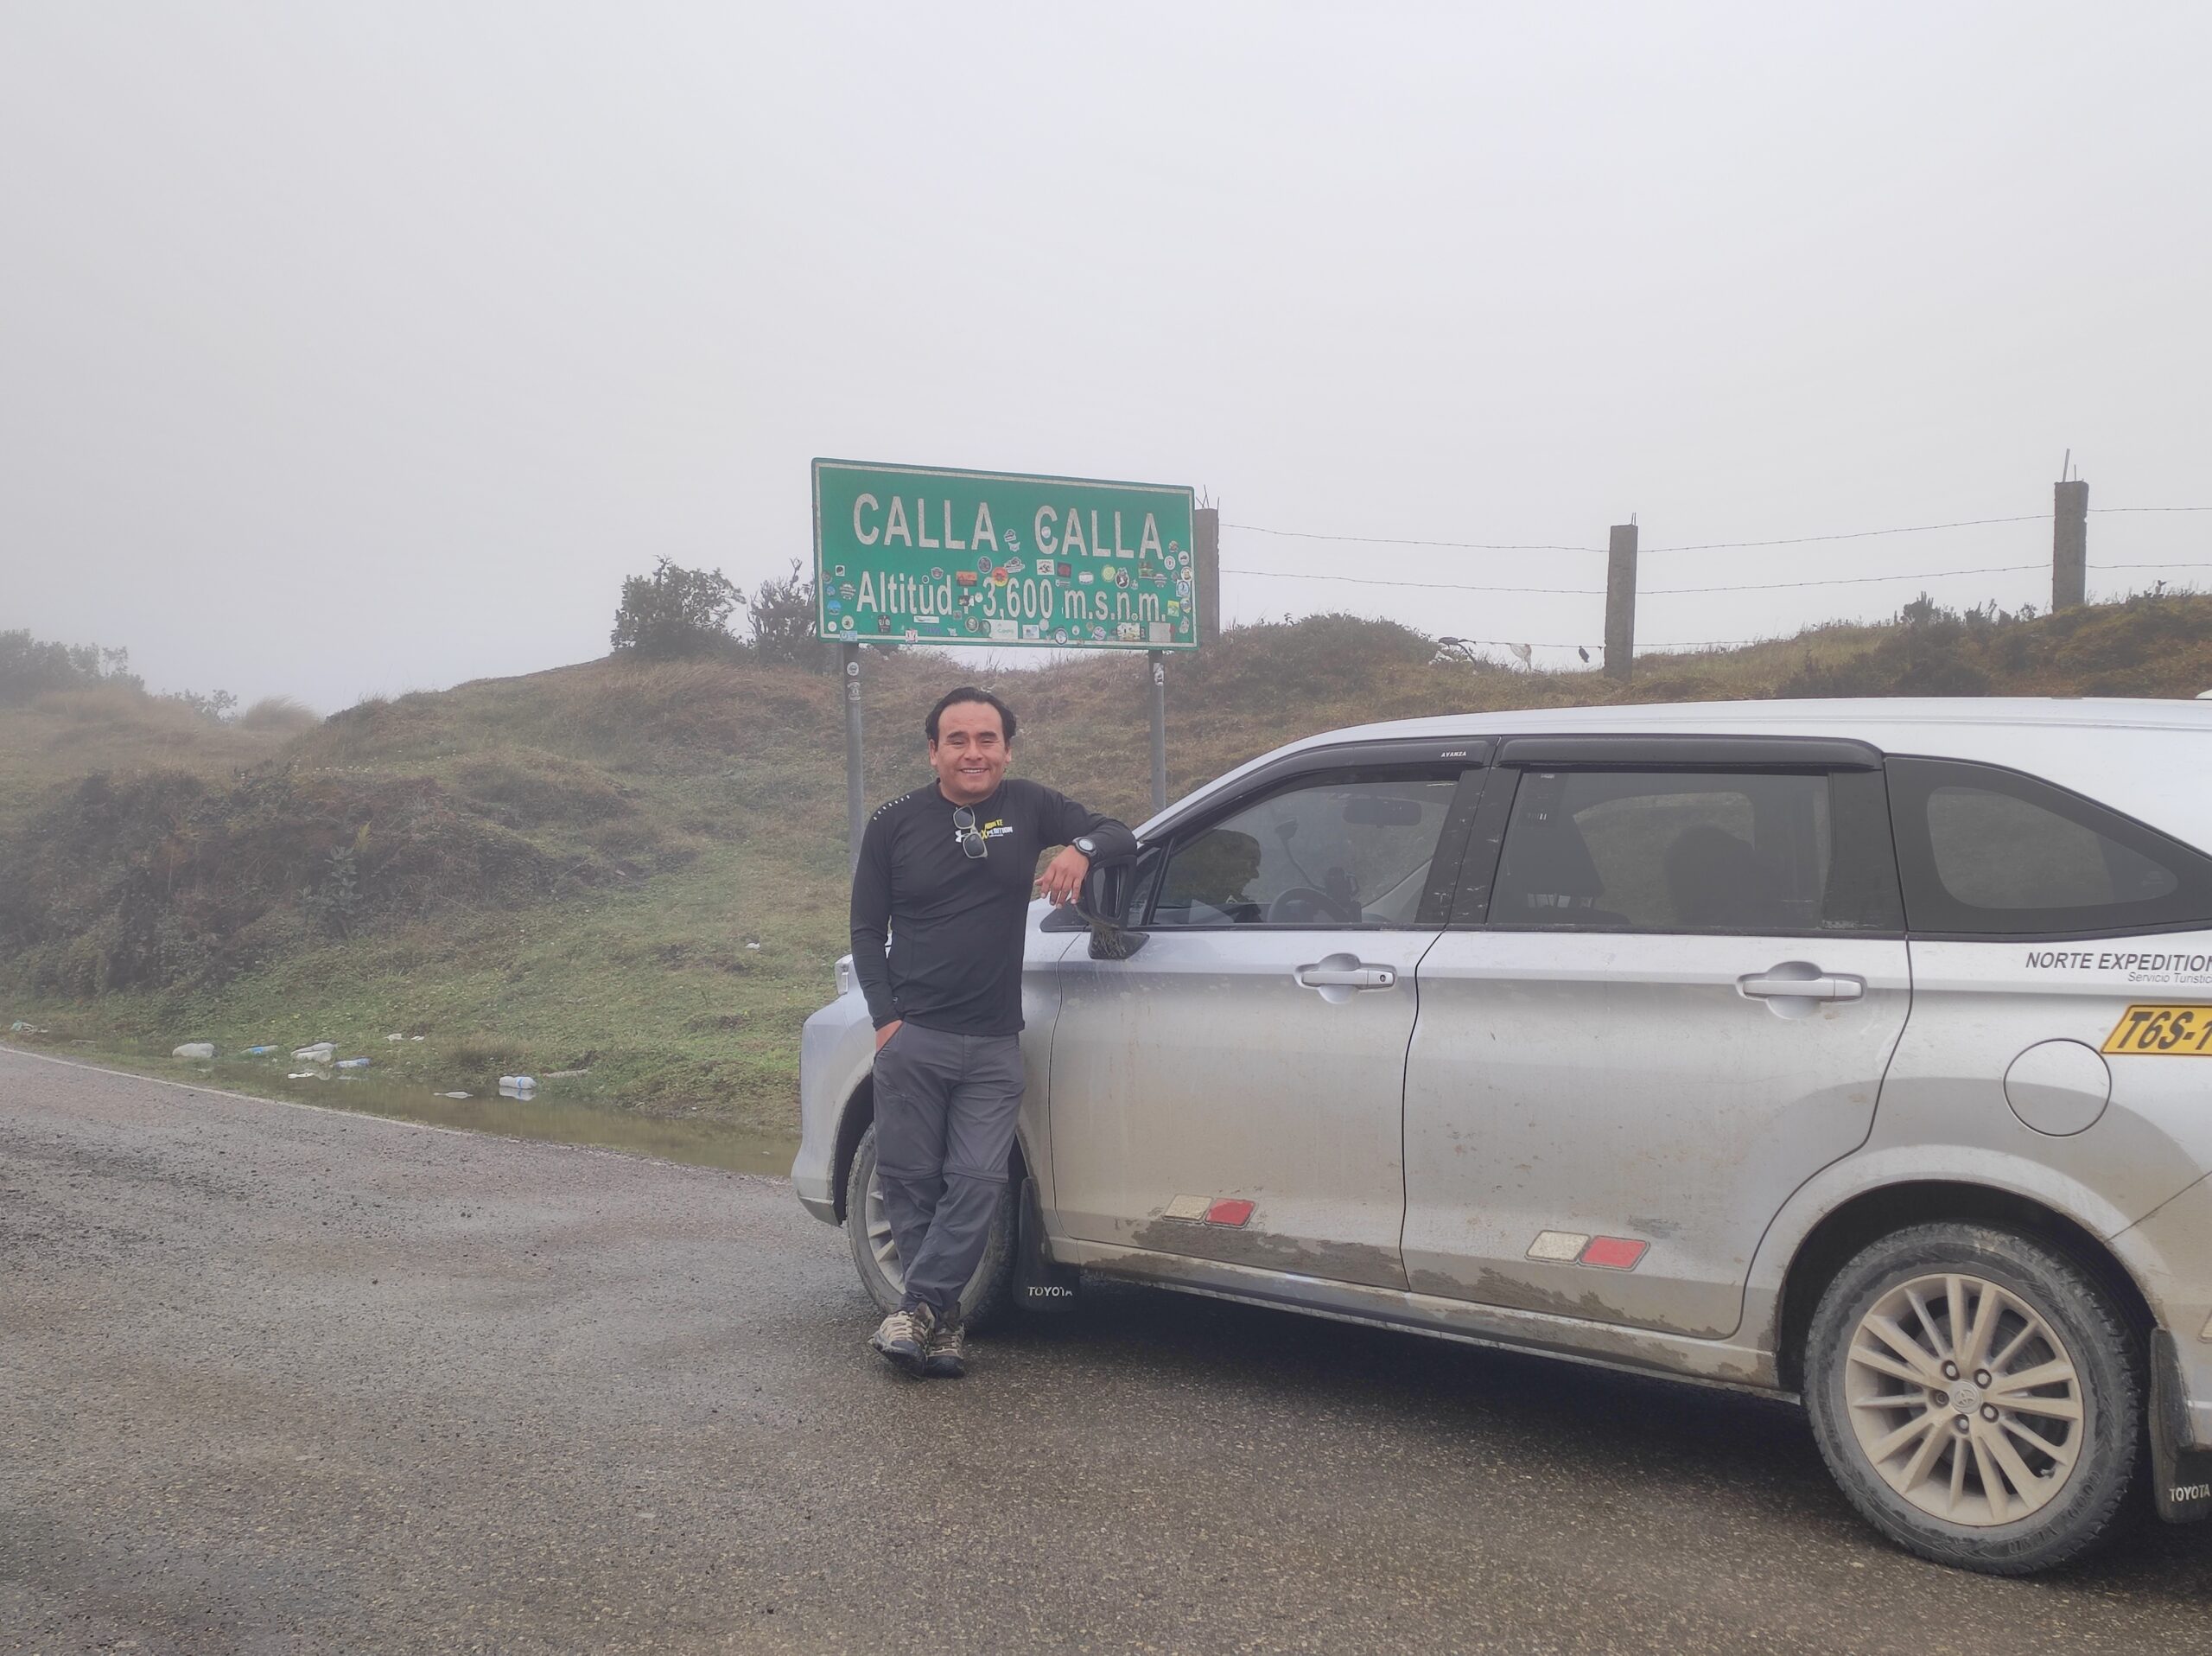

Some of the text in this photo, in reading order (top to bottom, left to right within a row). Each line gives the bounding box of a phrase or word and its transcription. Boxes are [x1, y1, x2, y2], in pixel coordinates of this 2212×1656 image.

[853, 493, 1164, 560] CALLA CALLA
[856, 570, 952, 615] Altitud
[982, 576, 1053, 621] 3,600
[1064, 589, 1166, 622] m.s.nm.
[2025, 952, 2094, 970] NORTE
[2127, 971, 2171, 983] Servicio
[2169, 1483, 2211, 1502] TOYOTA
